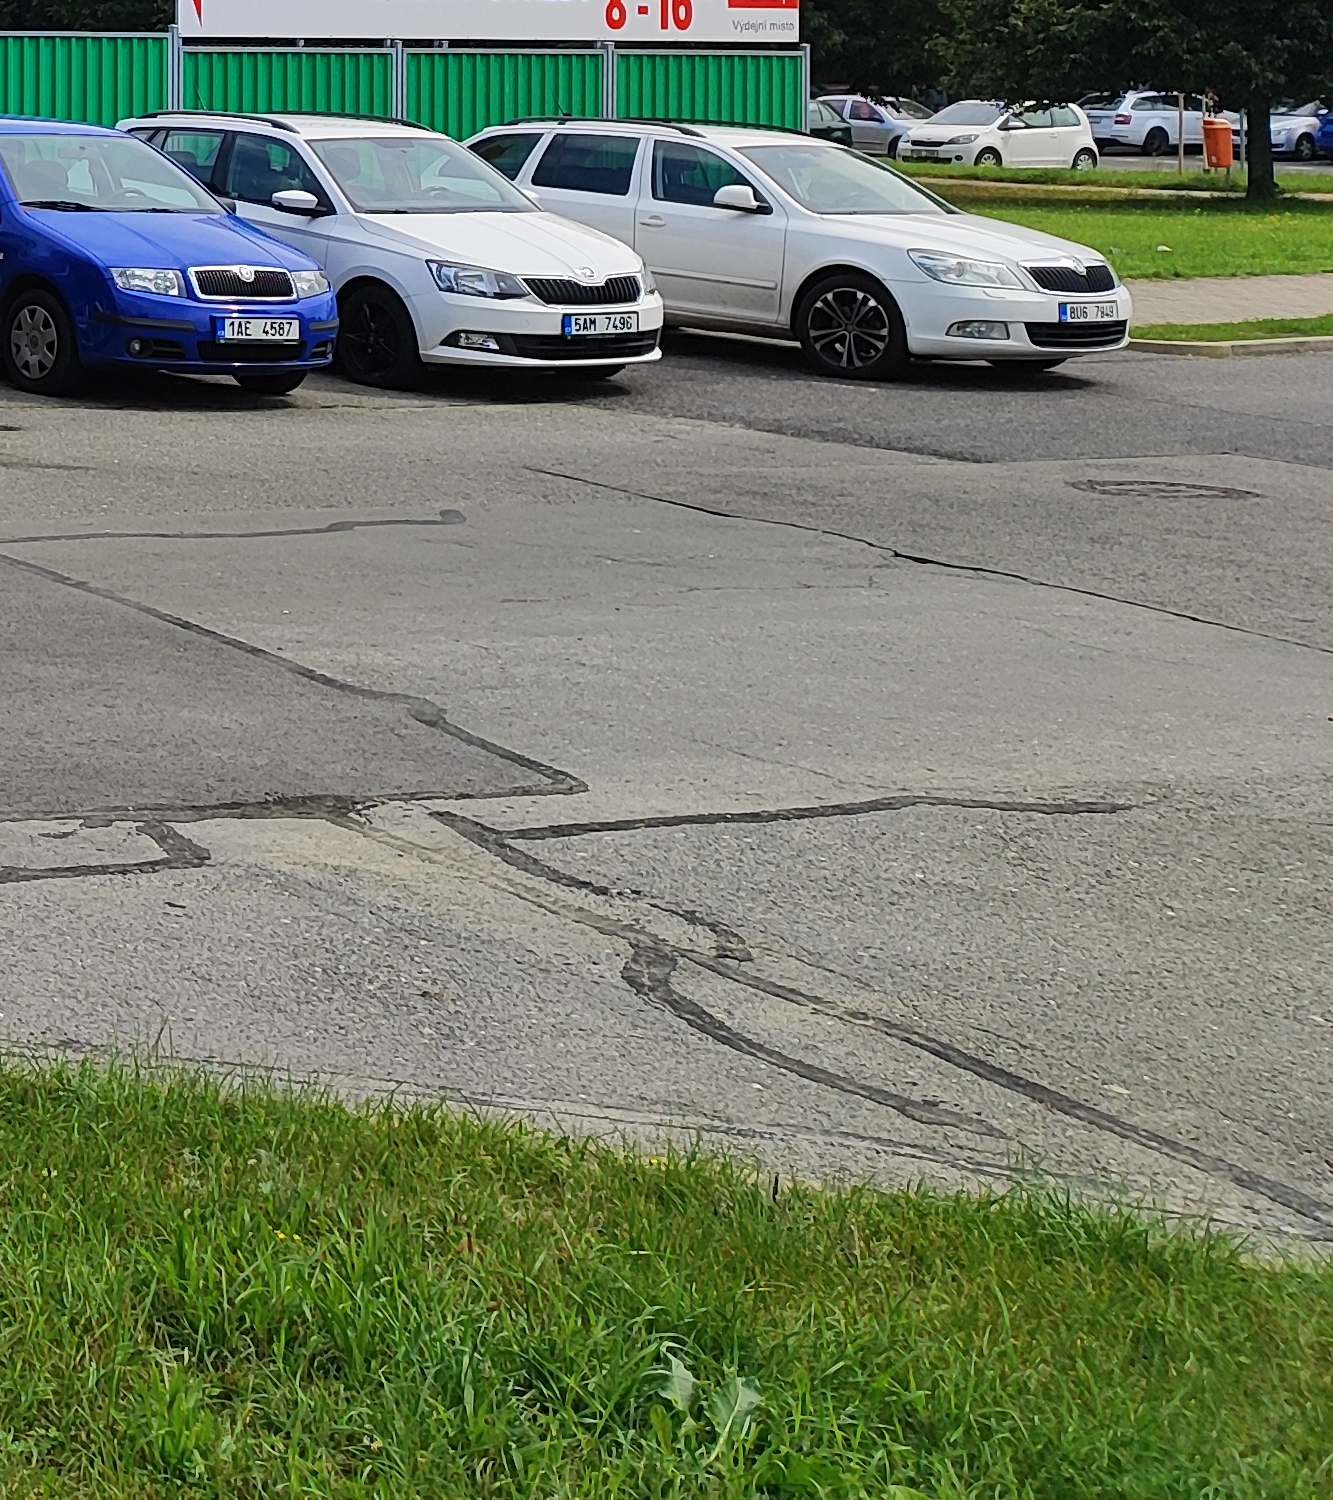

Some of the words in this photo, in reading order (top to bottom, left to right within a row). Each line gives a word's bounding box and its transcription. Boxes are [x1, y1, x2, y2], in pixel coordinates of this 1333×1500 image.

[732, 19, 767, 33] Výdejní
[228, 320, 252, 337] 1AE
[262, 321, 293, 337] 4587
